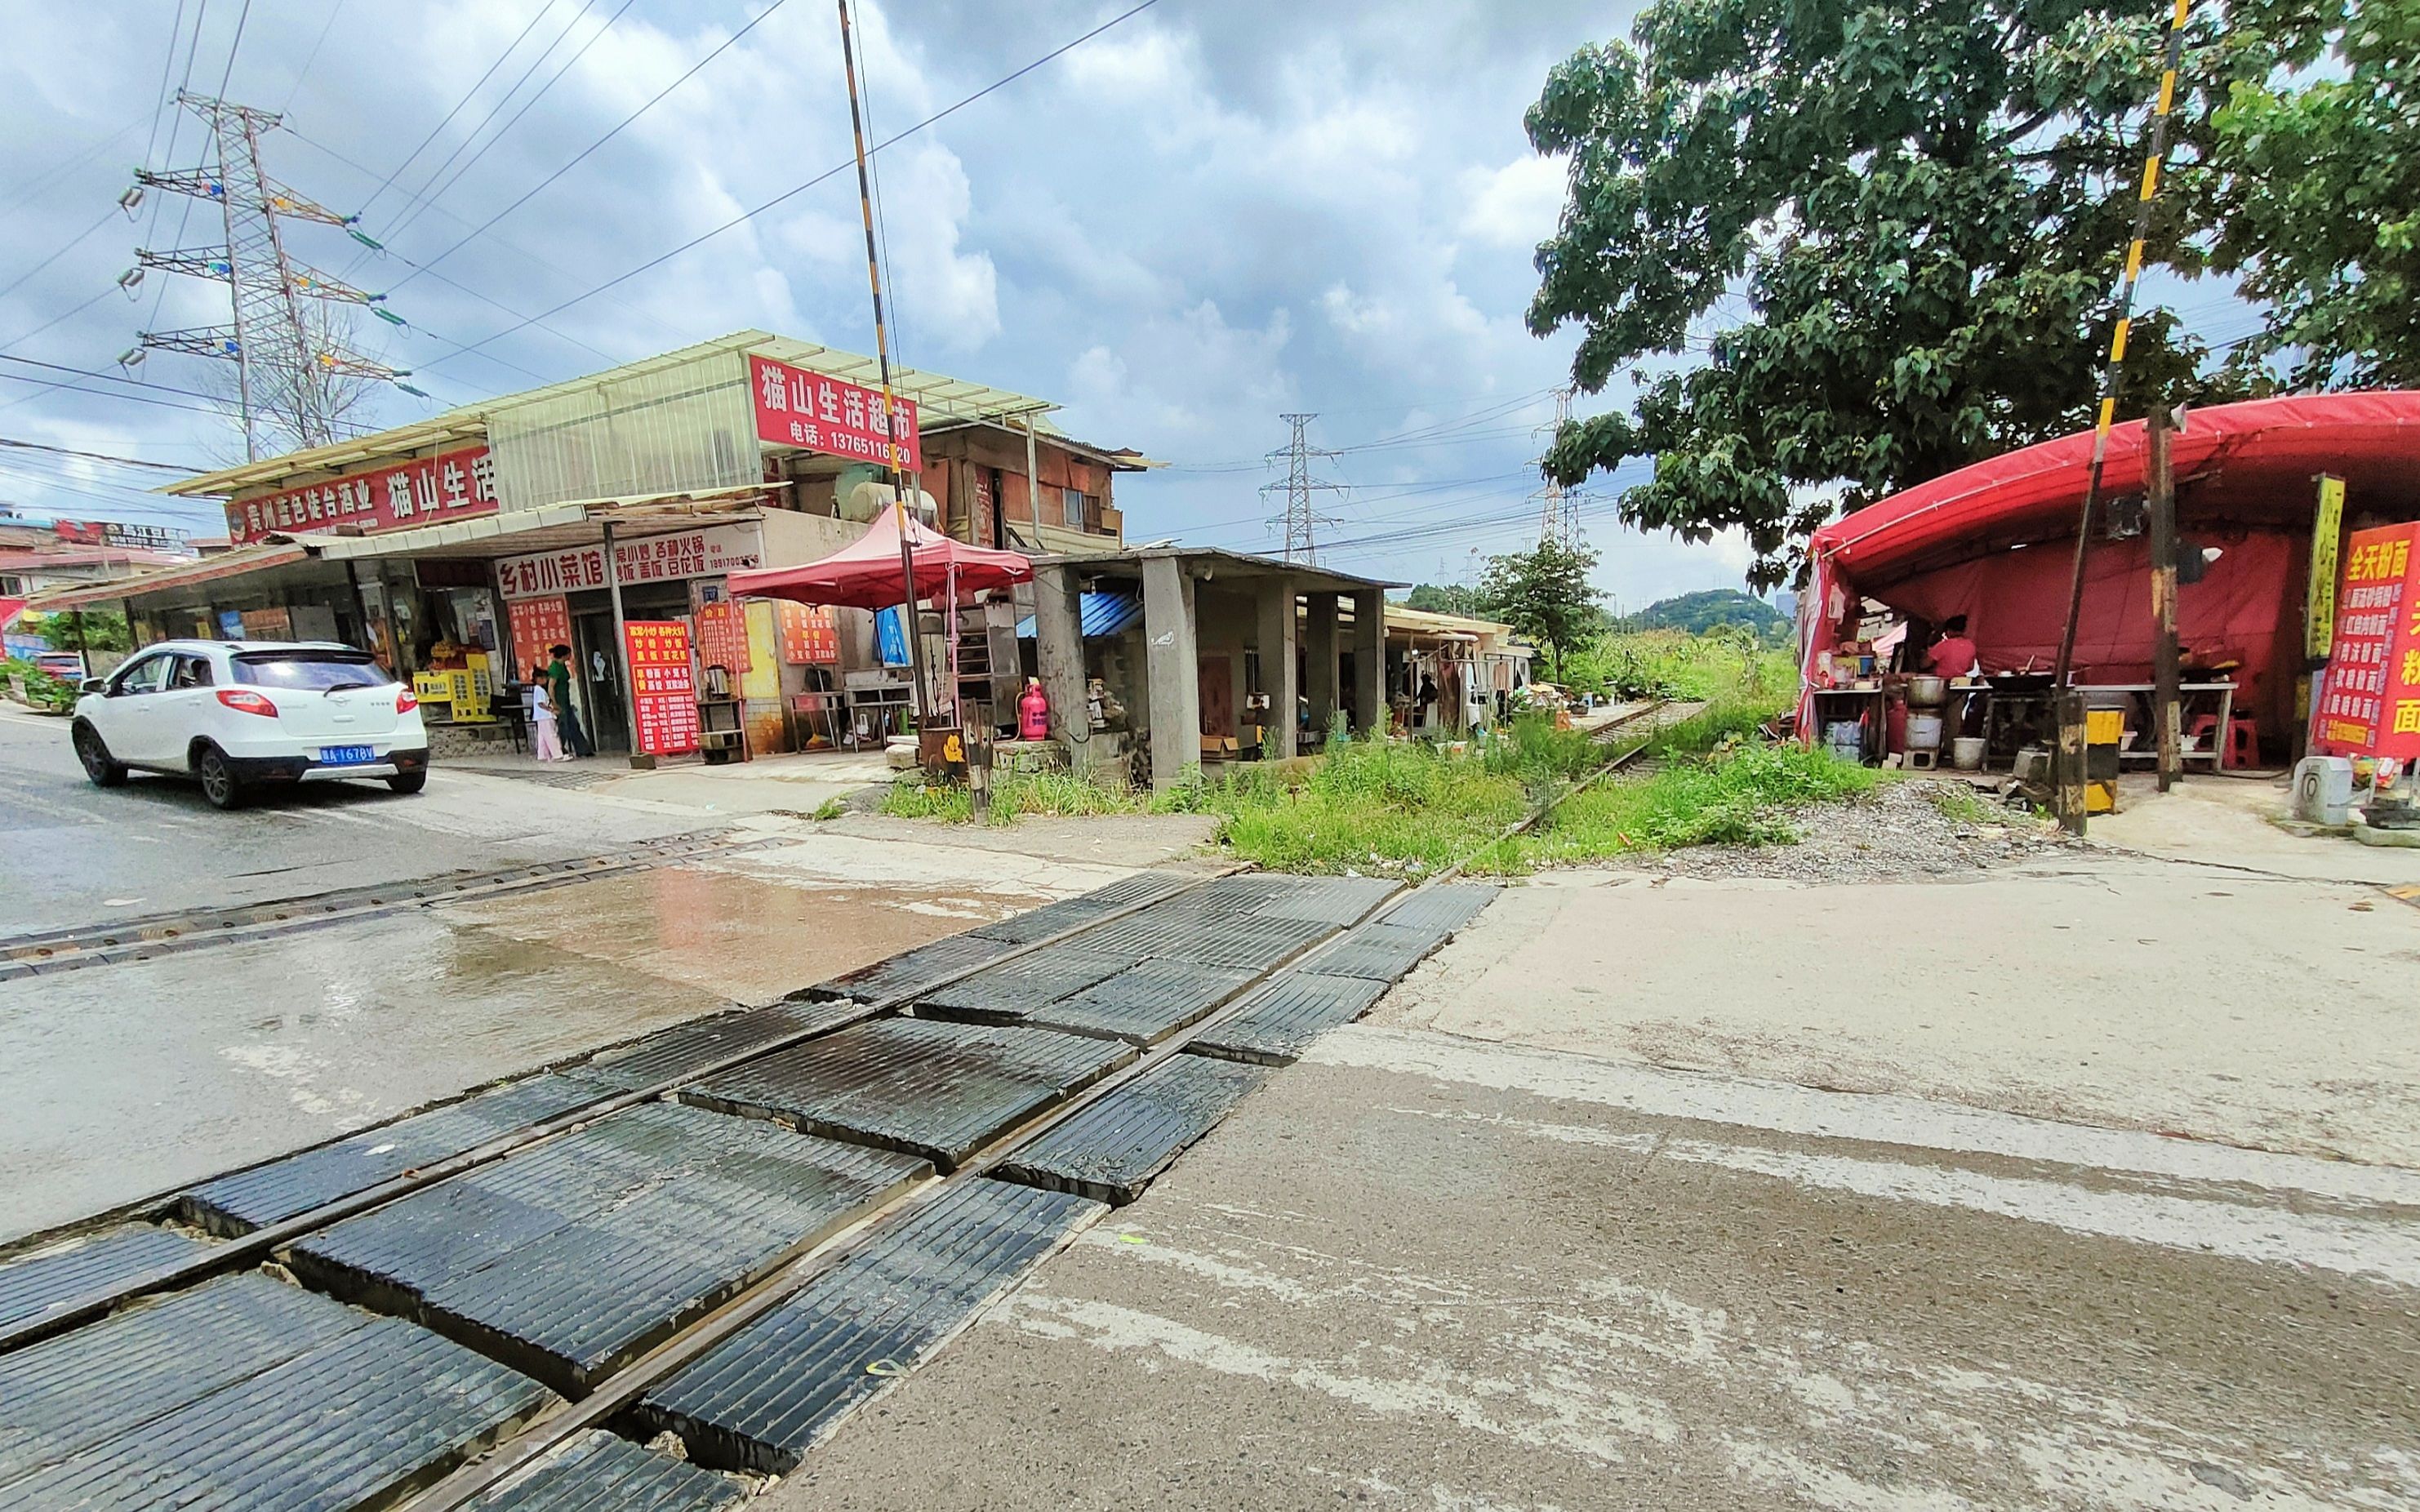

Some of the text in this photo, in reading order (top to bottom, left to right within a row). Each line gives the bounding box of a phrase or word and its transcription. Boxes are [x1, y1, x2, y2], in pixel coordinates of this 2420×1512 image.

[761, 364, 910, 441] 猫山生活超市
[614, 542, 651, 563] 常小炒
[656, 535, 705, 558] 各种火锅
[667, 554, 705, 576] 豆花饭
[2347, 540, 2411, 581] 全天粉面
[500, 550, 604, 595] 乡村小菜馆
